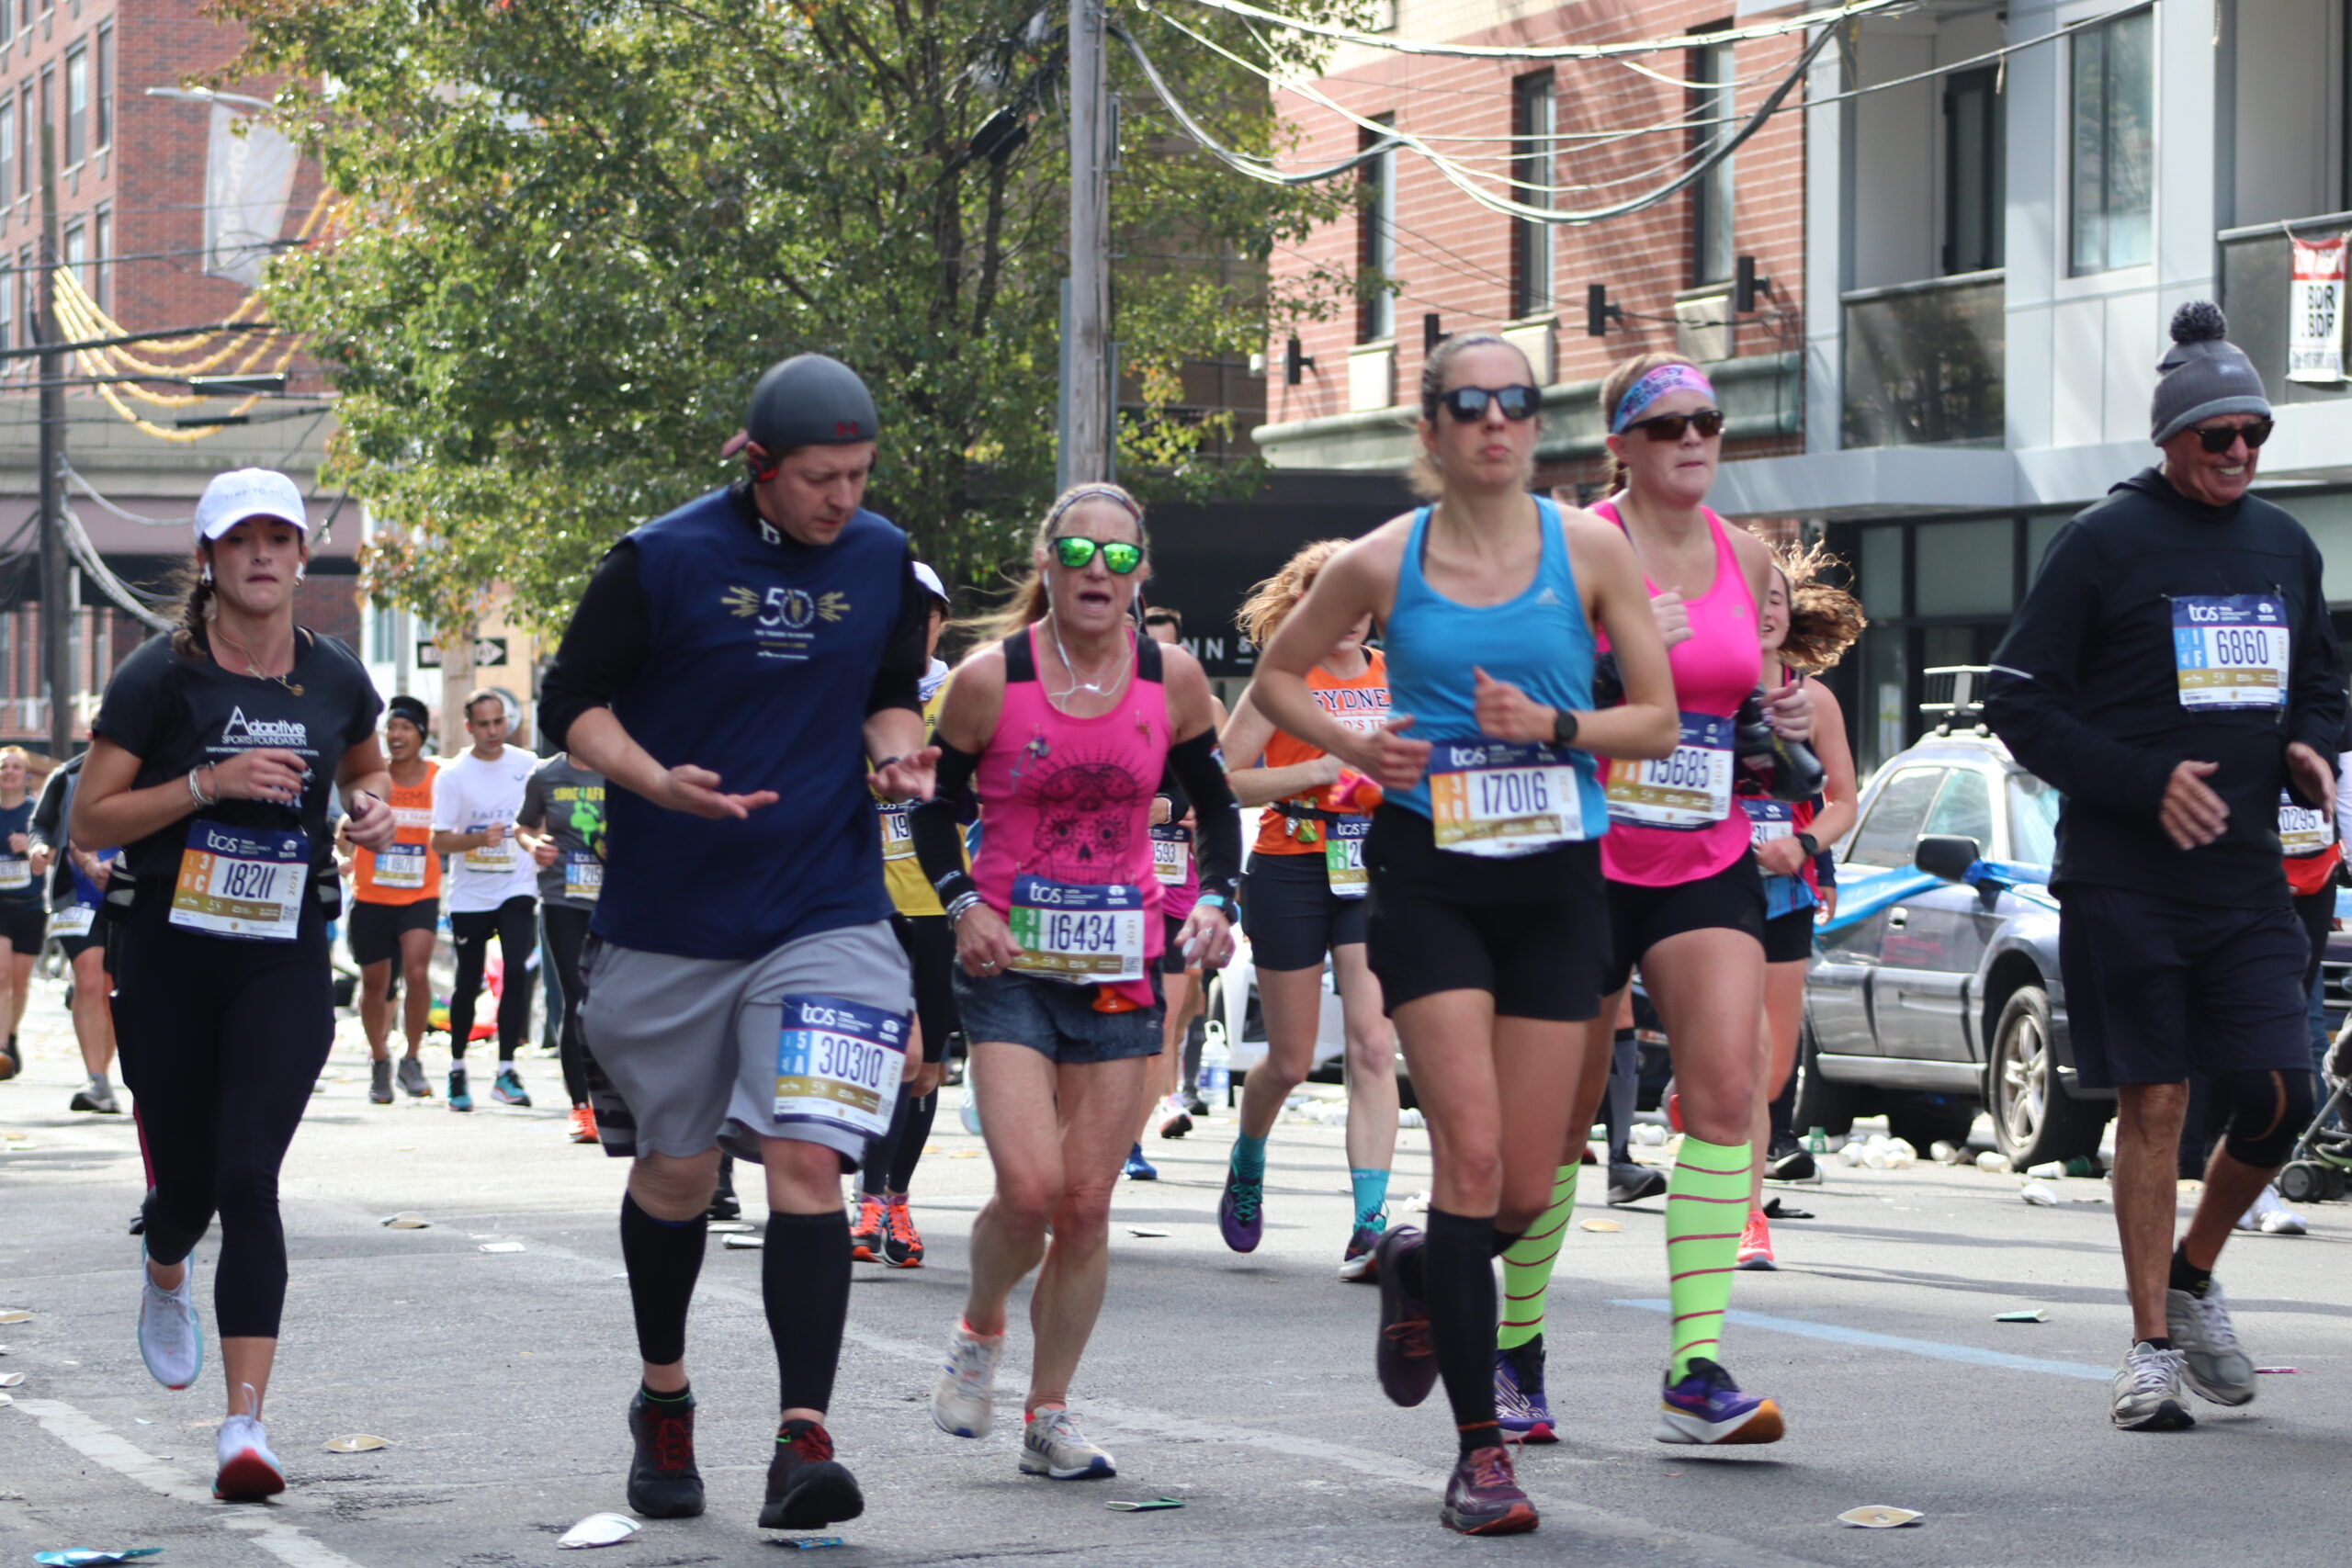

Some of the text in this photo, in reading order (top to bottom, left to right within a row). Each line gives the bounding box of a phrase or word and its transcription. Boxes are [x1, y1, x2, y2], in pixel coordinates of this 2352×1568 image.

[2188, 604, 2220, 622] tcs
[1180, 637, 1224, 660] NN
[2216, 629, 2269, 665] 6860
[223, 705, 307, 736] Adaptive
[221, 735, 308, 747] SPORTS FOUNDATION
[1451, 746, 1487, 767] tcs
[1481, 771, 1548, 815] 17016
[892, 814, 910, 839] 19
[2280, 807, 2317, 831] 0295
[207, 829, 239, 852] tcs
[198, 852, 210, 871] 3
[1155, 842, 1176, 863] 593
[194, 874, 207, 893] C
[222, 862, 277, 900] 18211
[582, 865, 604, 884] 215
[1029, 882, 1063, 904] tcs
[1026, 909, 1036, 927] 3
[1048, 914, 1116, 952] 16434
[800, 1002, 837, 1027] tcs
[797, 1031, 808, 1049] 5
[793, 1055, 805, 1074] A
[819, 1035, 884, 1089] 30310
